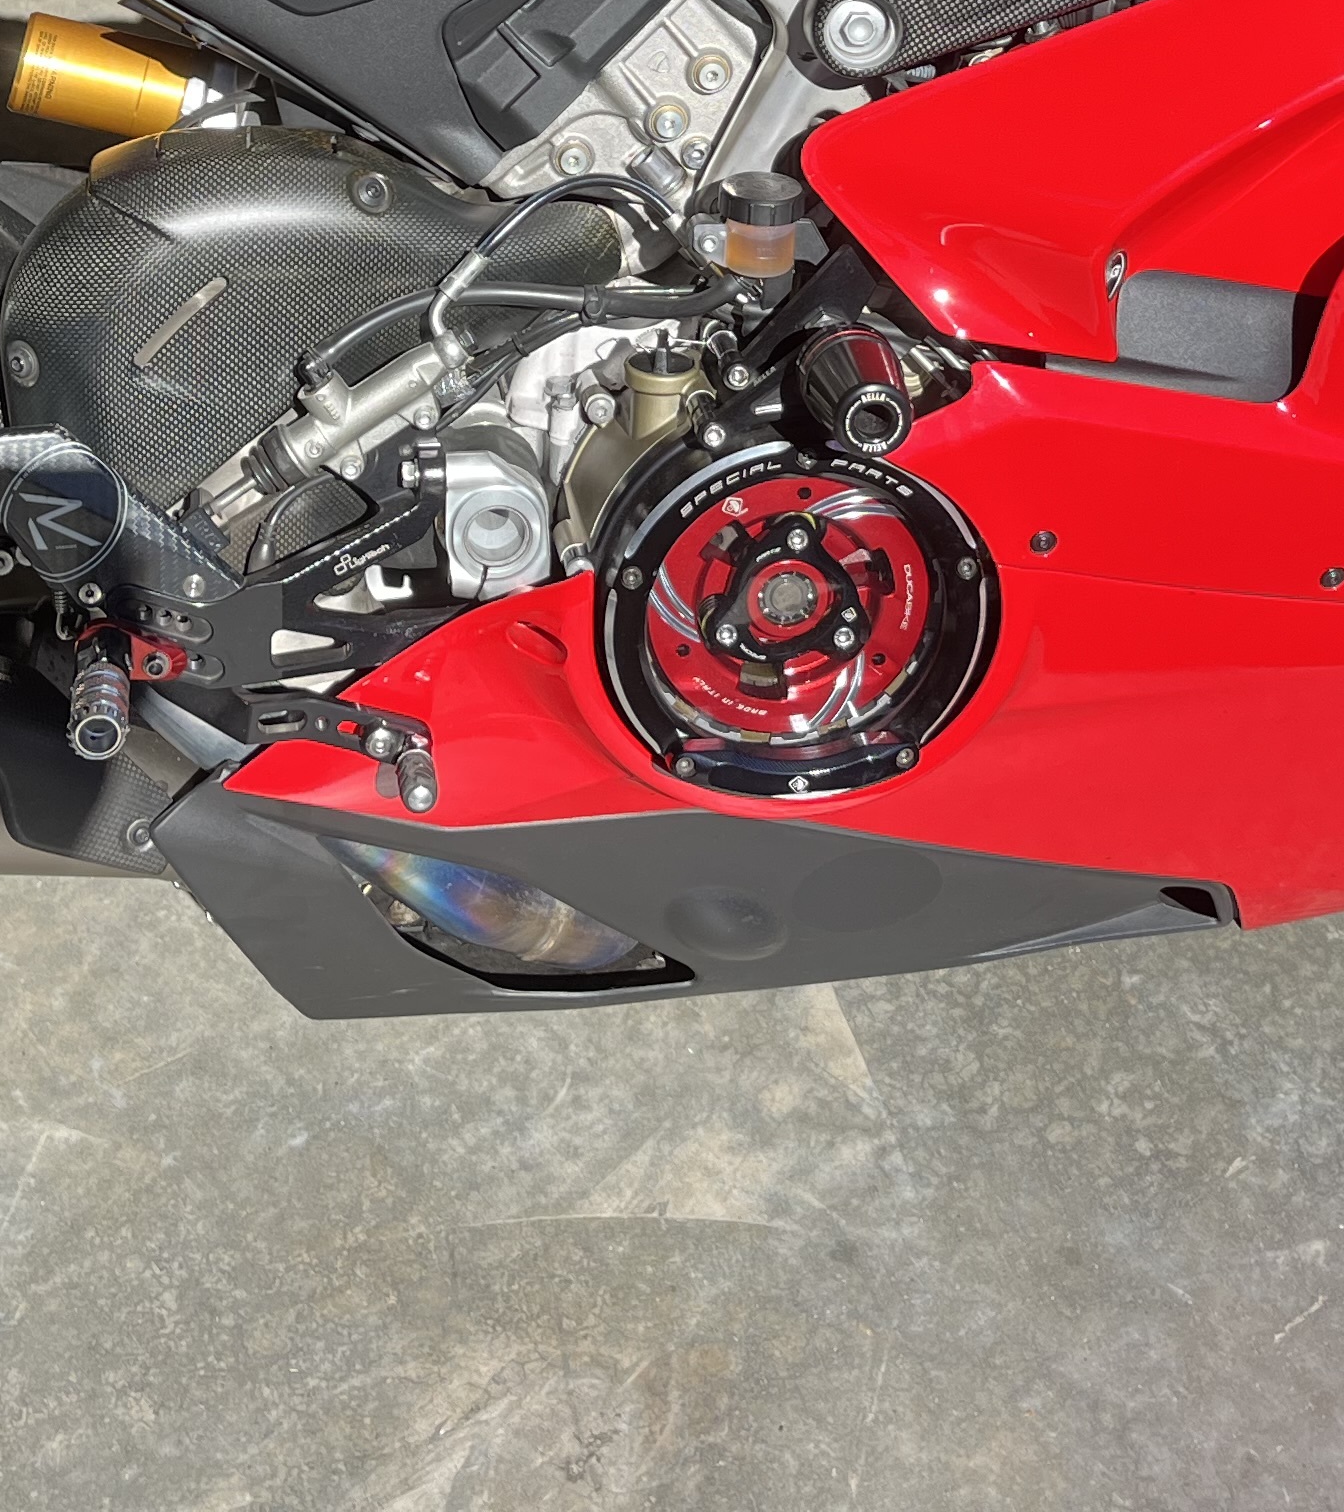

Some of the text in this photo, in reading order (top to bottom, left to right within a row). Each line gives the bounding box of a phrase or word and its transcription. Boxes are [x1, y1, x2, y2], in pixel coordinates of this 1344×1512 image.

[679, 458, 913, 519] SPECIAL PARTS
[899, 563, 914, 631] DUCABIKE
